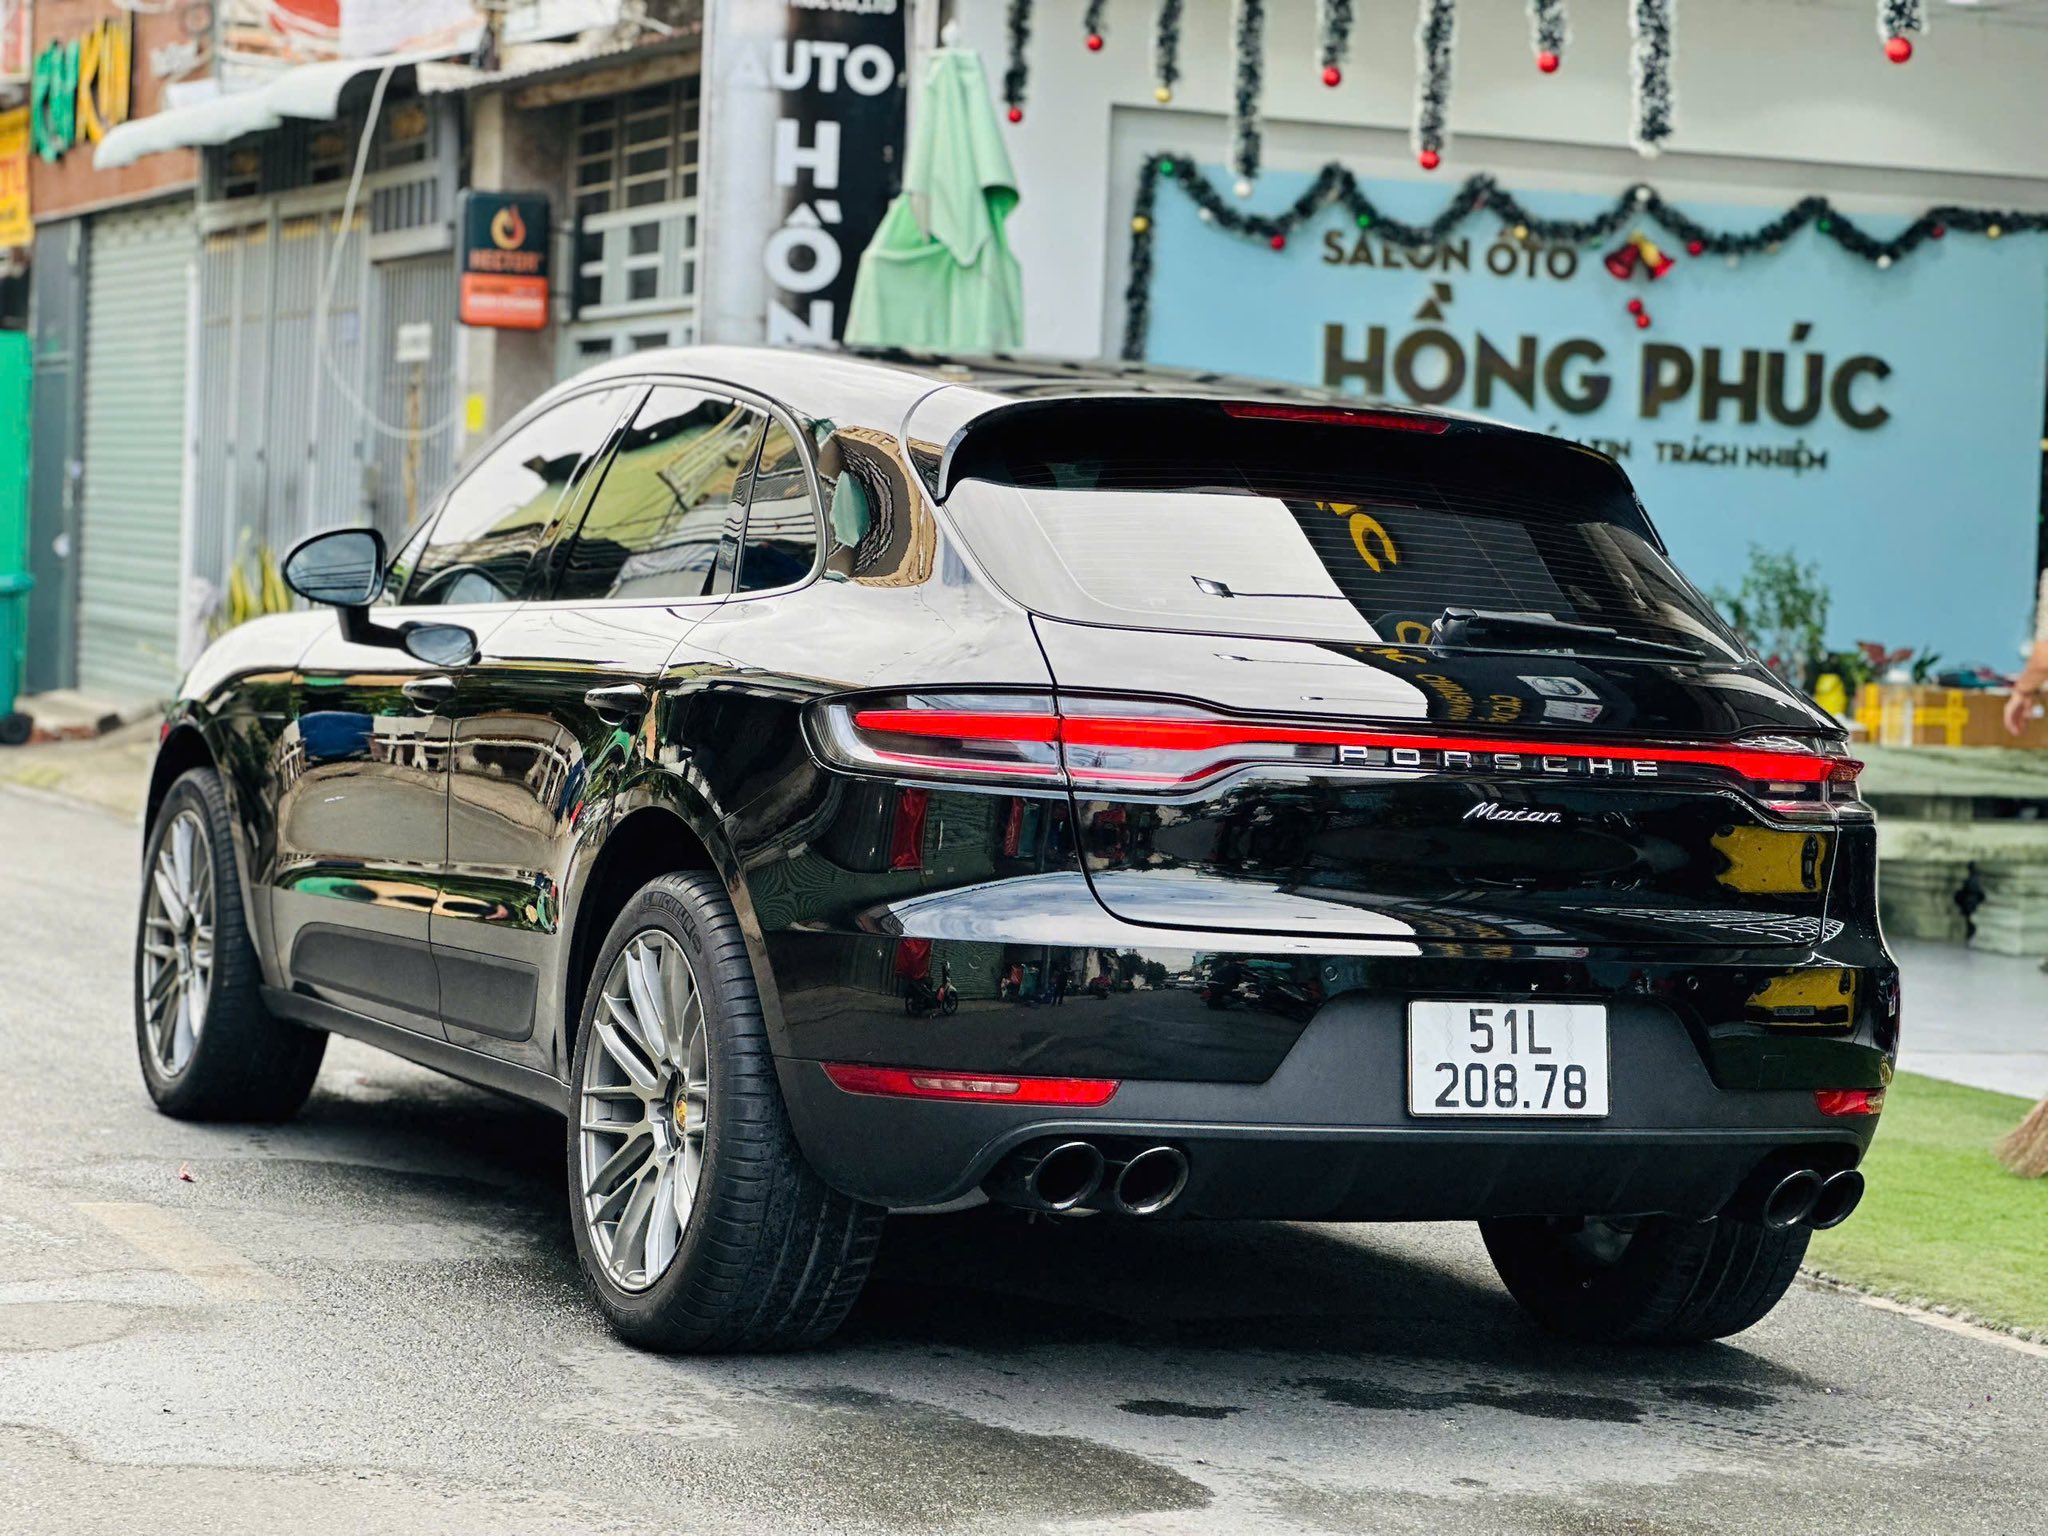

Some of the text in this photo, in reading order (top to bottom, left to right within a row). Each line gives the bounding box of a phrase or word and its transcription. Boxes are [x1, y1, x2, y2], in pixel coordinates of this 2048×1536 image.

[1324, 282, 1892, 431] HỒNG PHÚC
[1338, 744, 1659, 778] PORSCHE
[1463, 801, 1562, 824] Macan
[1469, 1007, 1552, 1055] 51L
[1434, 1062, 1588, 1110] 208.78
